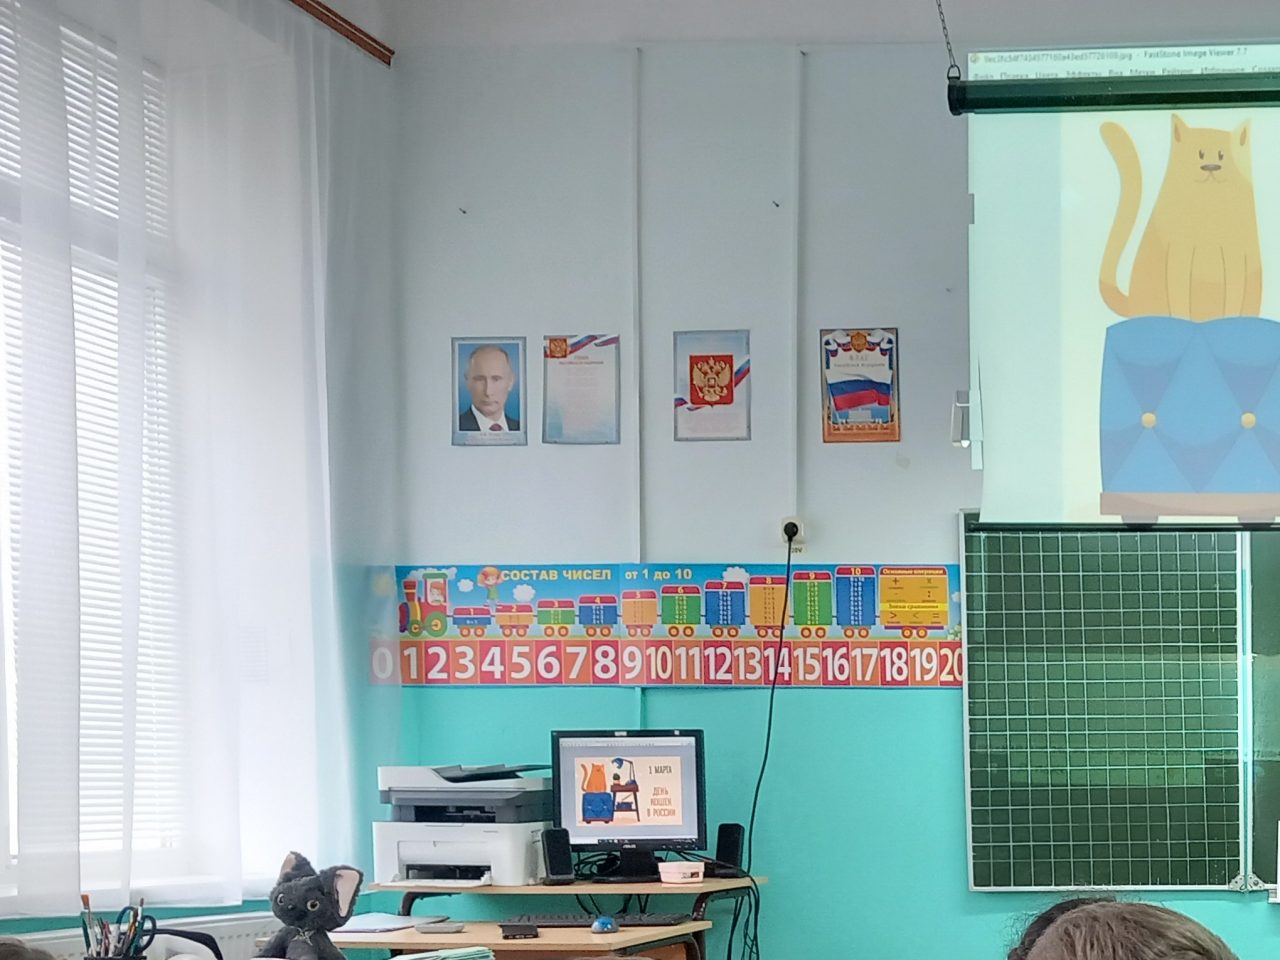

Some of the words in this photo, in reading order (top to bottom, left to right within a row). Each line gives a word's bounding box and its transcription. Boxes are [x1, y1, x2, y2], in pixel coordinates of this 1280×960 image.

[500, 569, 558, 581] СОСТАВ
[562, 569, 612, 580] ЧИСЕЛ
[624, 571, 639, 580] от
[642, 568, 648, 579] 1
[653, 571, 671, 581] до
[675, 568, 692, 579] 10
[850, 567, 862, 575] 10
[372, 646, 394, 680] 0
[403, 646, 418, 679] 1
[427, 646, 449, 680] 2
[454, 646, 475, 680] 3
[481, 646, 505, 679] 4
[510, 646, 531, 679] 5
[537, 645, 561, 680] 6
[565, 646, 588, 679] 7
[593, 645, 618, 680] 8
[622, 646, 644, 680] 9
[647, 646, 673, 680] 10
[675, 646, 700, 680] 11
[704, 646, 733, 680] 12
[734, 647, 762, 681] 13
[763, 647, 792, 680] 14
[793, 647, 822, 681] 15
[823, 647, 850, 681] 16
[851, 647, 879, 681] 17
[880, 648, 909, 681] 18
[910, 648, 938, 681] 19
[940, 648, 963, 681] 20
[654, 765, 673, 774] МАРТА
[652, 786, 669, 797] ДЕНЬ
[650, 797, 672, 807] КОШЕК
[652, 808, 676, 817] РОССИИ
